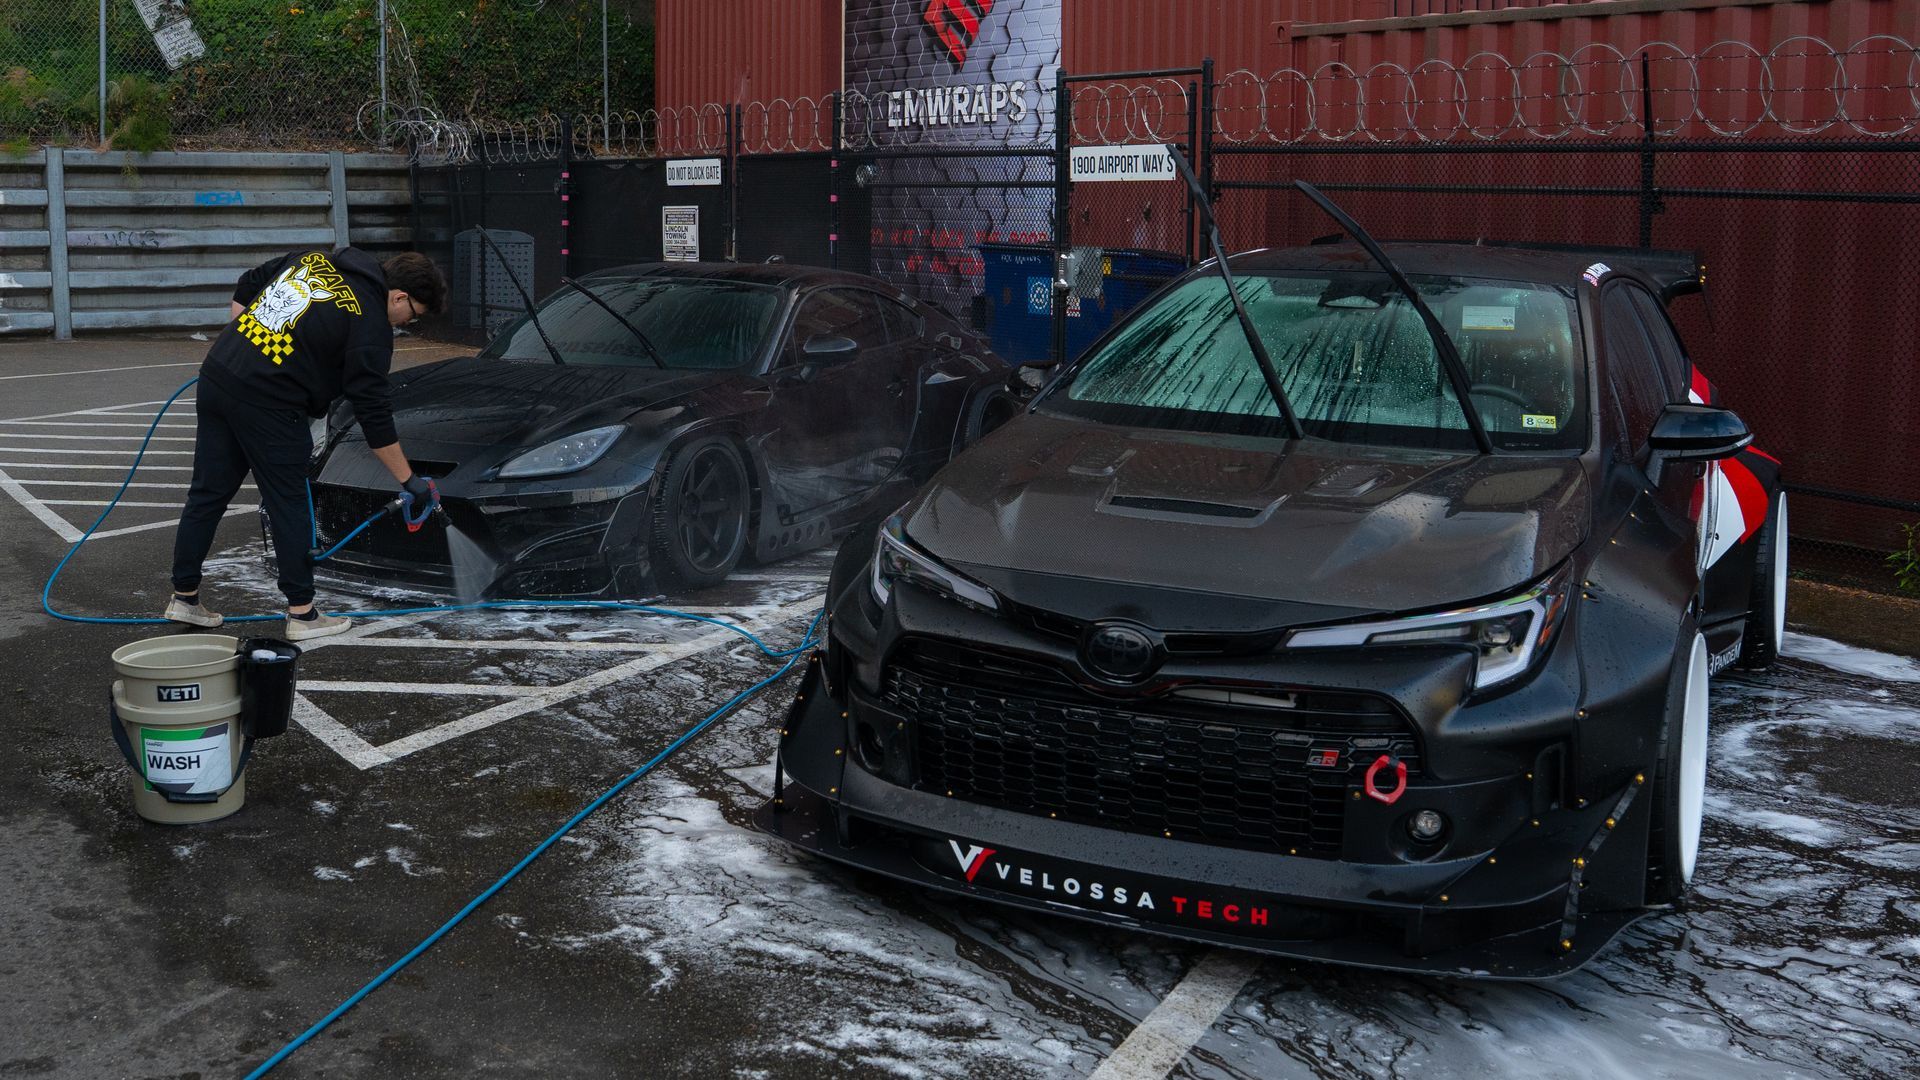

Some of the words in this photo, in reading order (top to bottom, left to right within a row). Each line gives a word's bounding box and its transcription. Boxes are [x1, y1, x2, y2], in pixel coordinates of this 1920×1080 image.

[888, 81, 1027, 127] EMWRAPS
[668, 167, 675, 180] DO
[676, 166, 686, 180] NOT
[687, 166, 705, 180] BLOCK
[706, 165, 720, 180] GATE
[1072, 156, 1096, 174] 1900
[1098, 155, 1140, 174] AIRPORT
[1142, 154, 1164, 173] WAY
[1167, 153, 1174, 172] S
[301, 253, 362, 315] STAFF
[1526, 417, 1534, 425] 8
[1714, 642, 1742, 673] PANDEM
[159, 686, 198, 700] YETI
[147, 754, 201, 771] WASH
[1309, 755, 1337, 766] GR
[996, 862, 1155, 910] VELOSSA
[1172, 896, 1268, 926] TECH
